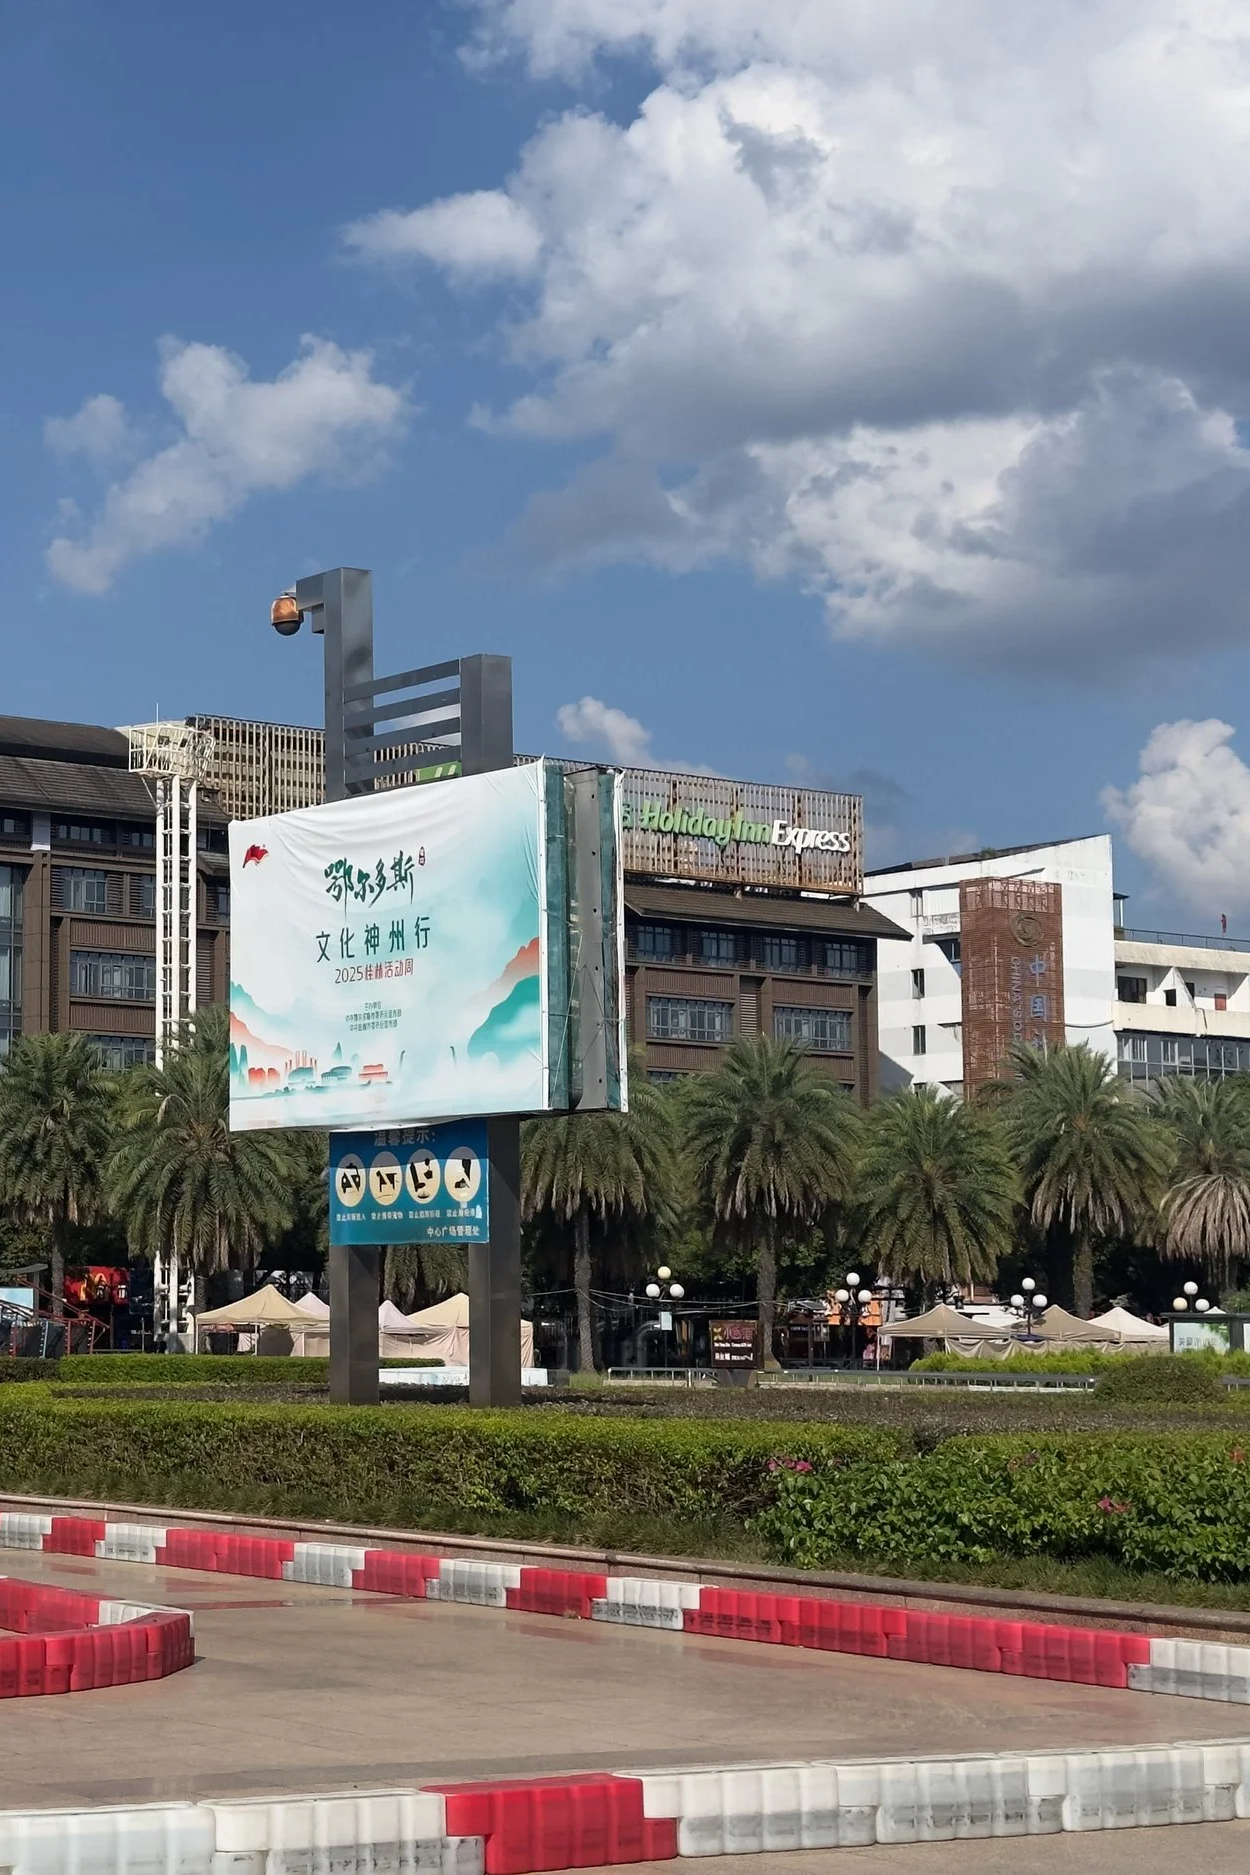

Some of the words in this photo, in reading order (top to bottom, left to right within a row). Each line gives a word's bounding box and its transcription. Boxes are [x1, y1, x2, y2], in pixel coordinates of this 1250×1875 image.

[639, 800, 732, 846] Holiday
[734, 808, 771, 844] Inn
[771, 819, 851, 854] Express
[324, 849, 416, 920] 鄂尔多斯
[315, 915, 431, 963] 文化神州行
[334, 957, 415, 985] 2025桂林活动周
[427, 1225, 480, 1237] 中心广场管理处
